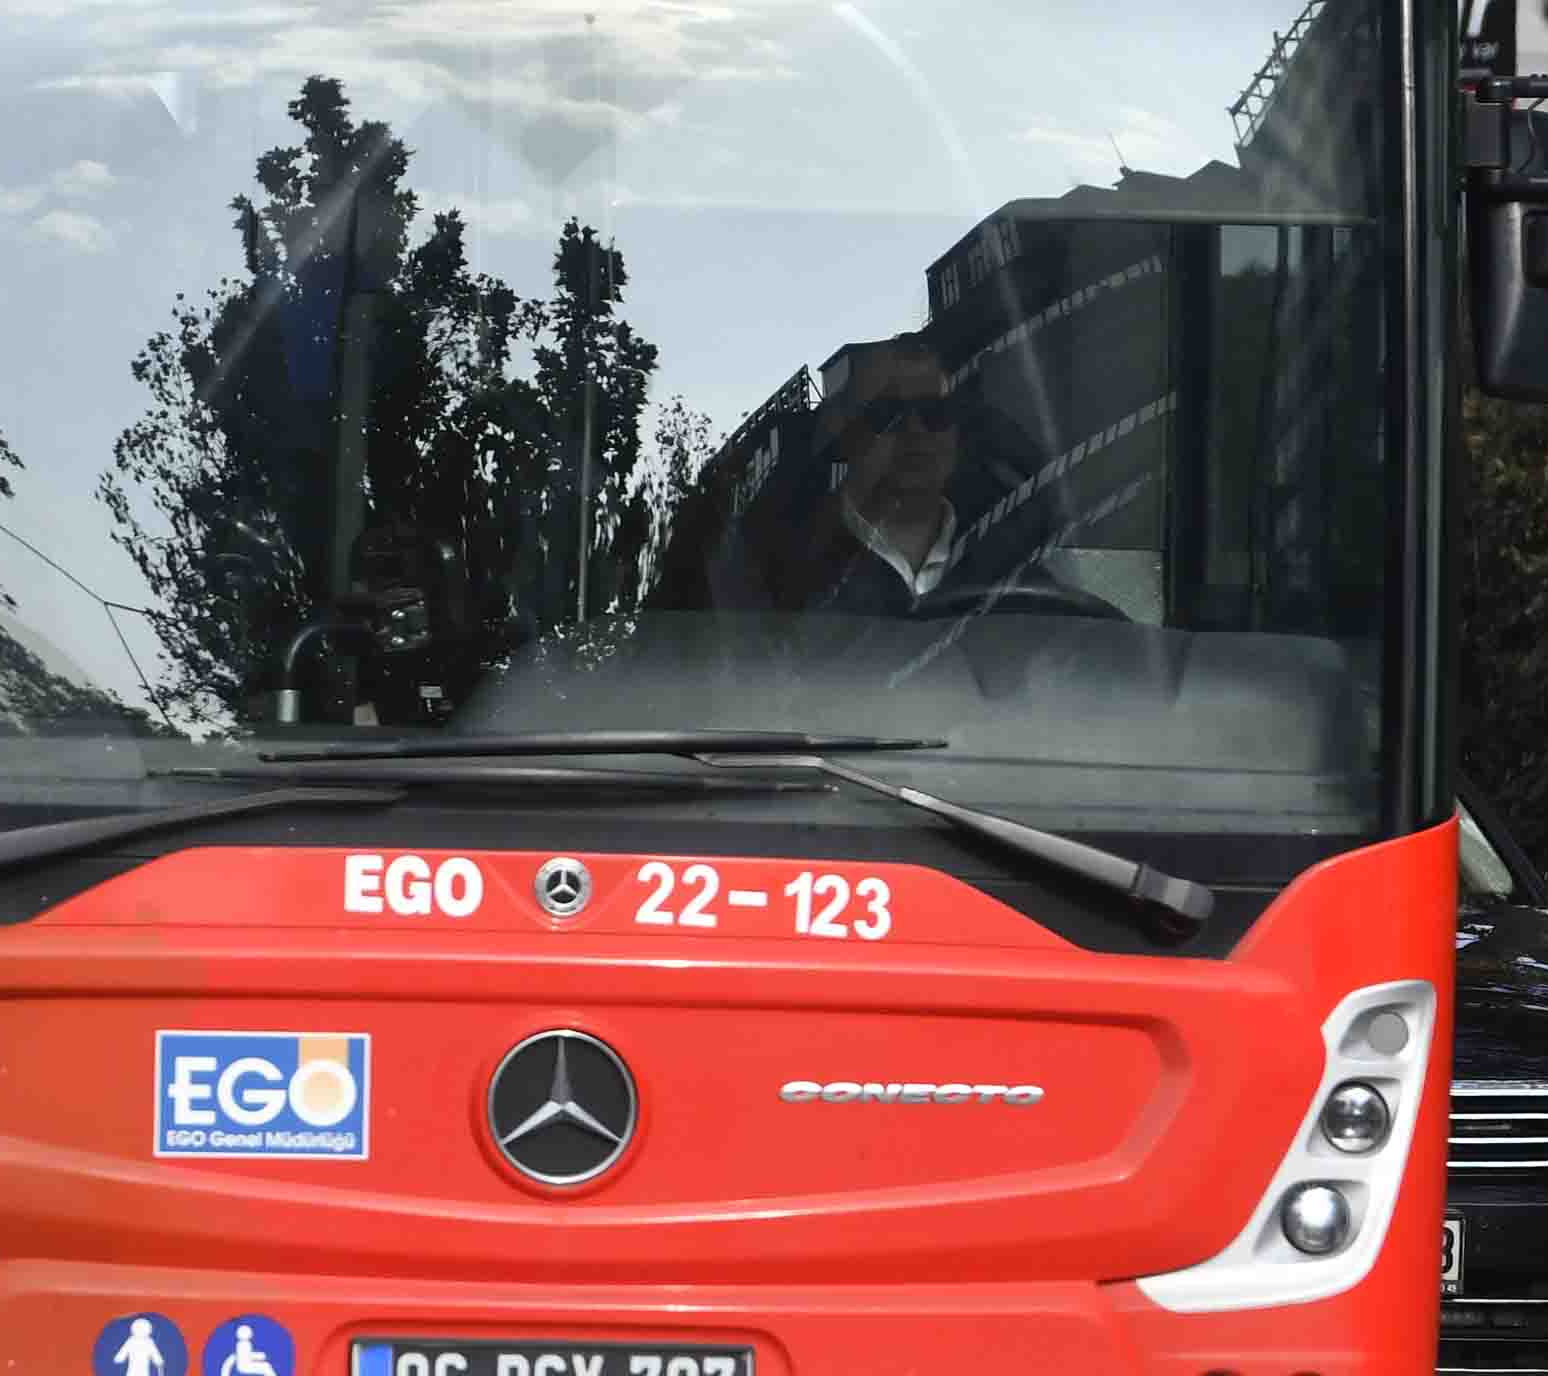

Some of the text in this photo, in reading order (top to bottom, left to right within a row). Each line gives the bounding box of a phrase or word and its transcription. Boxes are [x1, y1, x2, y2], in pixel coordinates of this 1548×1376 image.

[343, 854, 484, 918] EGO
[167, 1055, 358, 1127] EGO
[778, 1080, 1045, 1105] CONECTO
[166, 1130, 206, 1148] EGO
[209, 1130, 264, 1148] Genel
